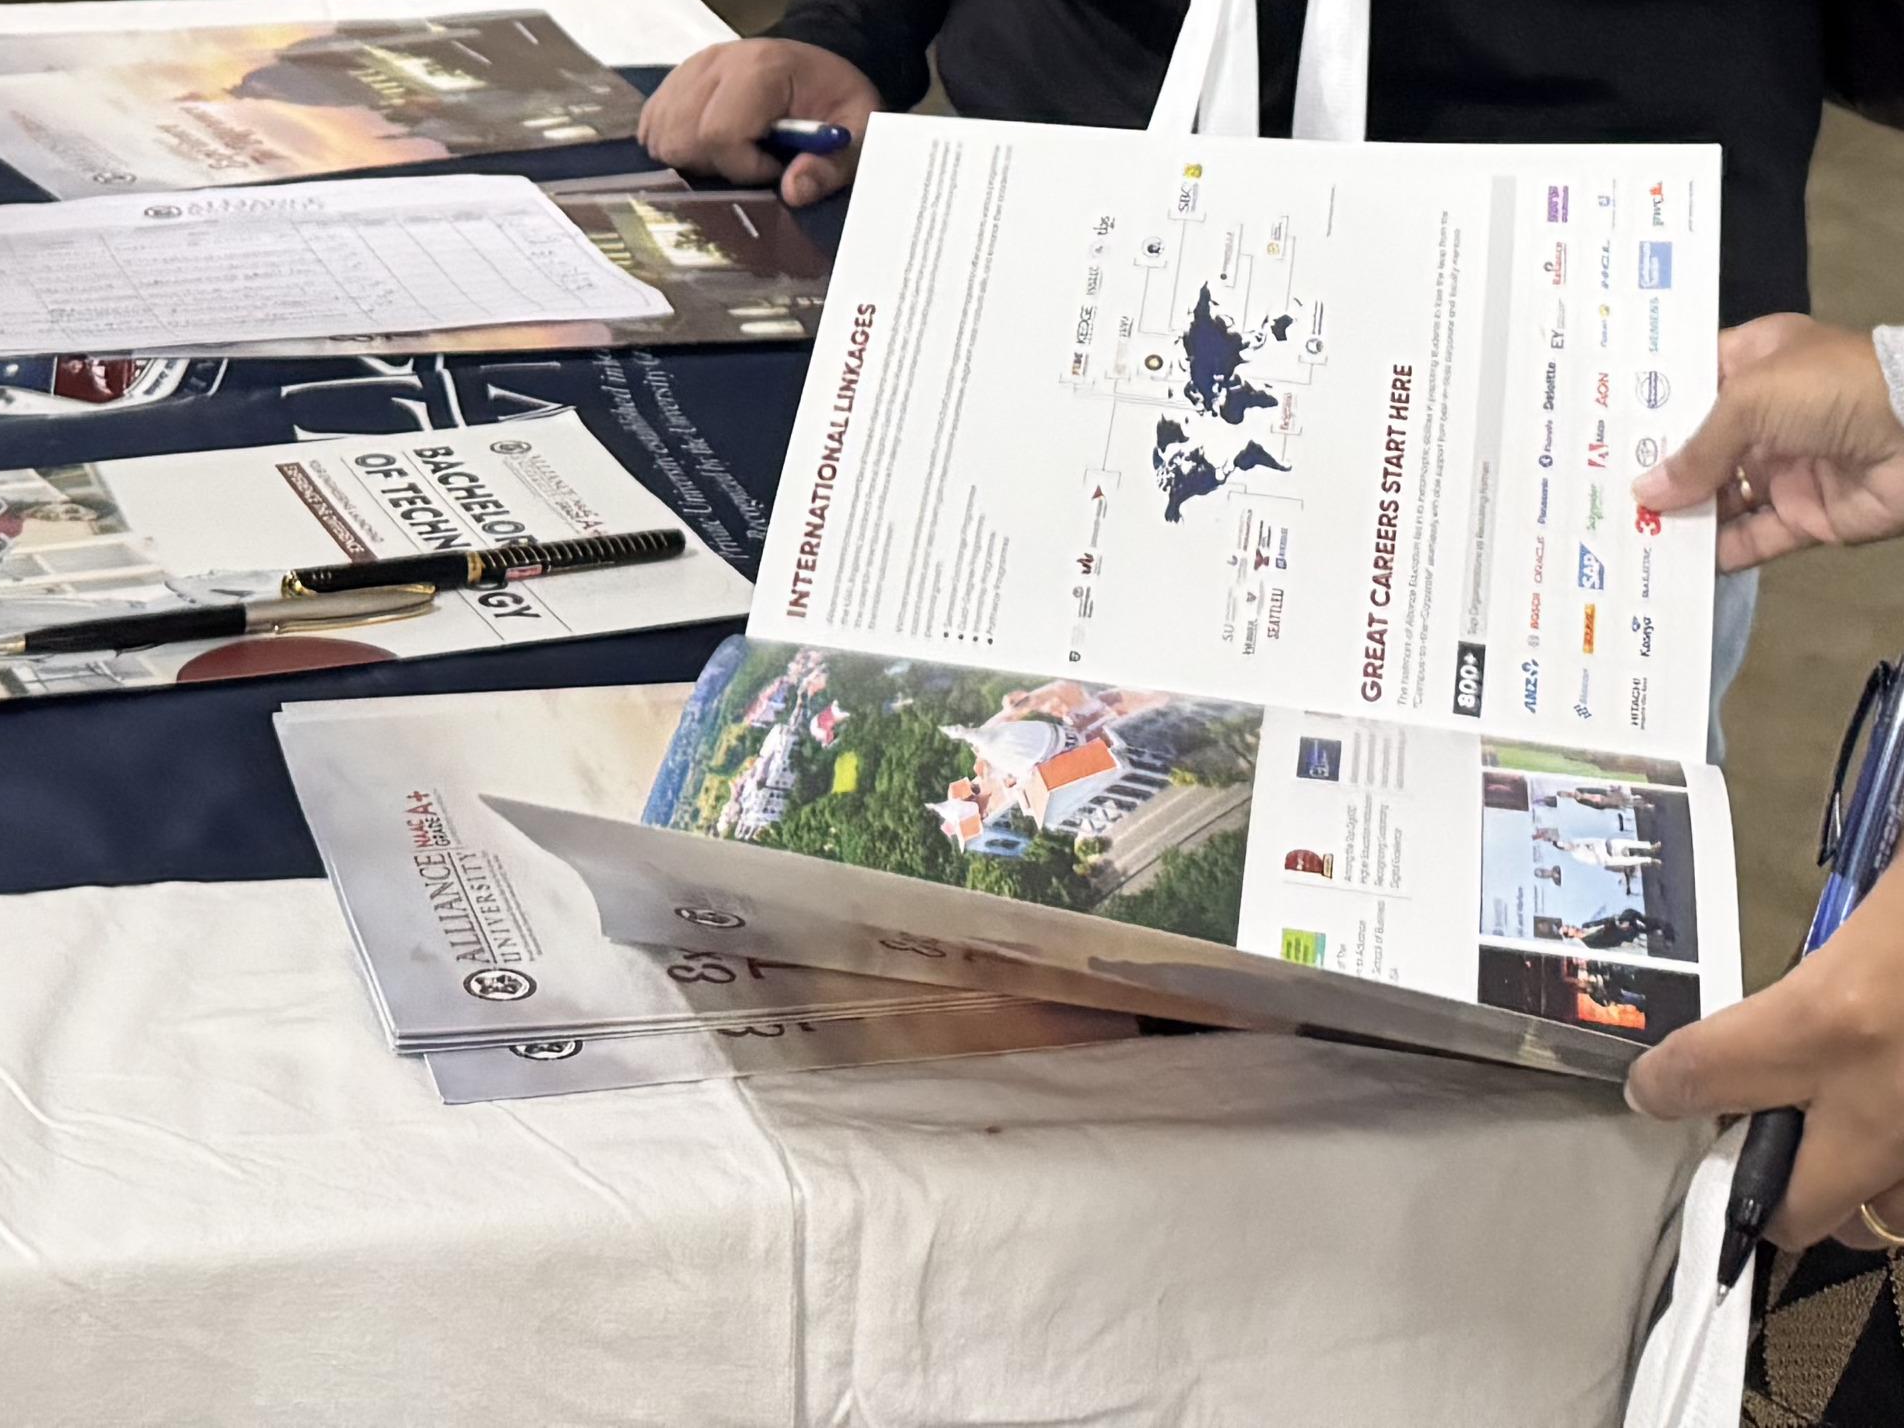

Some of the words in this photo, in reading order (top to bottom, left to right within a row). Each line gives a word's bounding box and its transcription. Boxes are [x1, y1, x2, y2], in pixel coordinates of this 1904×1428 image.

[1550, 329, 1565, 350] EY
[1388, 363, 1413, 421] HERE
[1542, 361, 1557, 411] Deloitte
[1595, 372, 1609, 409] AON
[786, 417, 851, 619] INTERNATIONAL
[832, 302, 877, 413] LINKAGES
[1380, 425, 1408, 494] START
[354, 452, 403, 483] OF
[382, 482, 542, 620] TECHNGY
[1369, 498, 1400, 607] CAREERS
[1582, 553, 1599, 589] SAP
[1360, 610, 1389, 703] GREAT
[1457, 651, 1480, 709] 800+
[1523, 676, 1538, 714] ANZ
[1629, 677, 1641, 726] HITACHI
[404, 790, 437, 817] A+
[406, 819, 433, 849] NAAC
[425, 817, 451, 848] GRADE
[413, 852, 491, 964] ALLIANCE
[455, 851, 522, 964] UNIVERSITY
